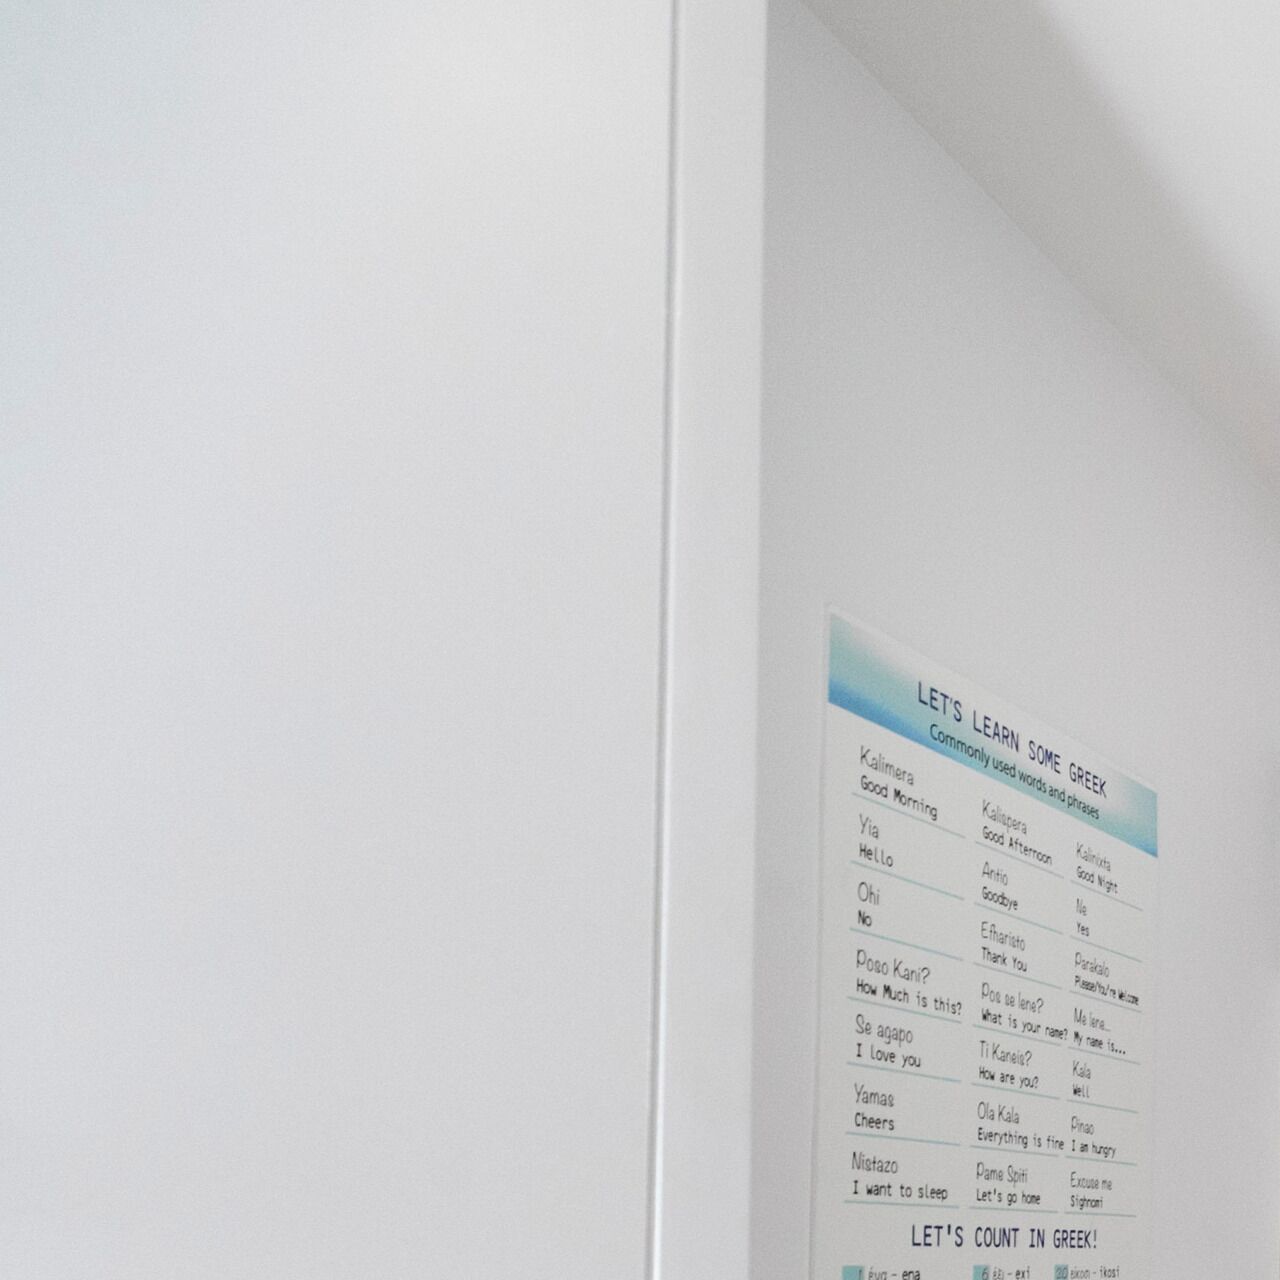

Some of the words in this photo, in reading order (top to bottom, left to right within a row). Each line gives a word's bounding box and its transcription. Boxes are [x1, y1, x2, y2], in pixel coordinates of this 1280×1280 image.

[918, 681, 962, 722] LET'S
[973, 710, 1019, 752] LEARN
[1028, 740, 1060, 774] SOME
[1069, 762, 1106, 797] GREEK
[860, 745, 914, 786] Kalimera
[930, 723, 990, 768] Commonly
[992, 757, 1016, 778] used
[1018, 770, 1046, 793] words
[1048, 785, 1065, 802] and
[1067, 794, 1099, 820] phrases
[860, 774, 888, 798] Good
[893, 788, 937, 821] Morning
[859, 813, 879, 839] Yia
[982, 799, 1027, 835] Kalispera
[859, 843, 893, 867] Hello
[982, 825, 1004, 845] Good
[1008, 836, 1052, 864] Afternoon
[982, 861, 1008, 886] Antio
[1076, 865, 1094, 883] Good
[1097, 874, 1117, 893] Night
[857, 881, 879, 905] Ohi
[982, 886, 1018, 910] Goodbye
[858, 910, 872, 927] No
[1076, 898, 1087, 916] Ne
[981, 921, 1025, 951] Efharisto
[1077, 922, 1089, 936] Yes
[856, 949, 888, 975] Poso
[893, 958, 930, 984] Kani?
[981, 946, 1007, 965] Thank
[1012, 957, 1027, 972] You
[1074, 951, 1109, 977] Parakalo
[856, 978, 877, 995] How
[883, 984, 908, 1002] Much
[916, 991, 927, 1008] is
[934, 997, 962, 1015] this?
[981, 1008, 1002, 1025] What
[1008, 1014, 1017, 1029] is
[1021, 1021, 1041, 1033] your
[1045, 1026, 1068, 1040] name?
[1074, 1007, 1086, 1026] Me
[855, 1013, 871, 1035] Se
[877, 1024, 913, 1047] agapo
[856, 1042, 862, 1057] I
[870, 1045, 896, 1063] love
[902, 1055, 921, 1067] you
[1074, 1031, 1082, 1046] My
[1087, 1036, 1103, 1049] name
[1107, 1039, 1125, 1054] is...
[979, 1067, 995, 1080] How
[1000, 1072, 1015, 1084] are
[1019, 1076, 1038, 1088] you?
[1072, 1060, 1091, 1079] Kala
[854, 1083, 894, 1107] Yamas
[1073, 1085, 1089, 1097] Well
[854, 1112, 894, 1130] Cheers
[977, 1101, 994, 1120] Ola
[998, 1104, 1019, 1124] Kala
[1071, 1115, 1094, 1135] Pinao
[977, 1127, 1028, 1149] Everything
[1033, 1133, 1042, 1147] is
[1046, 1135, 1064, 1150] fine
[1071, 1139, 1075, 1151] I
[1080, 1143, 1088, 1152] am
[1092, 1143, 1116, 1158] hungry
[852, 1151, 898, 1174] Nistazo
[976, 1161, 1003, 1181] Pame
[1007, 1164, 1027, 1186] Spiti
[853, 1180, 858, 1194] I
[866, 1183, 891, 1196] want
[899, 1184, 912, 1198] to
[918, 1184, 947, 1201] sleep
[976, 1188, 1002, 1202] Let's
[1007, 1193, 1017, 1206] go
[1022, 1191, 1040, 1204] home
[912, 1224, 963, 1247] LET'S
[975, 1226, 1019, 1247] COUNT
[1029, 1228, 1044, 1248] IN
[1053, 1229, 1096, 1248] GREEK!
[902, 1270, 920, 1280] ena
[1015, 1266, 1029, 1280] exi
[1099, 1265, 1119, 1278] ikosi
